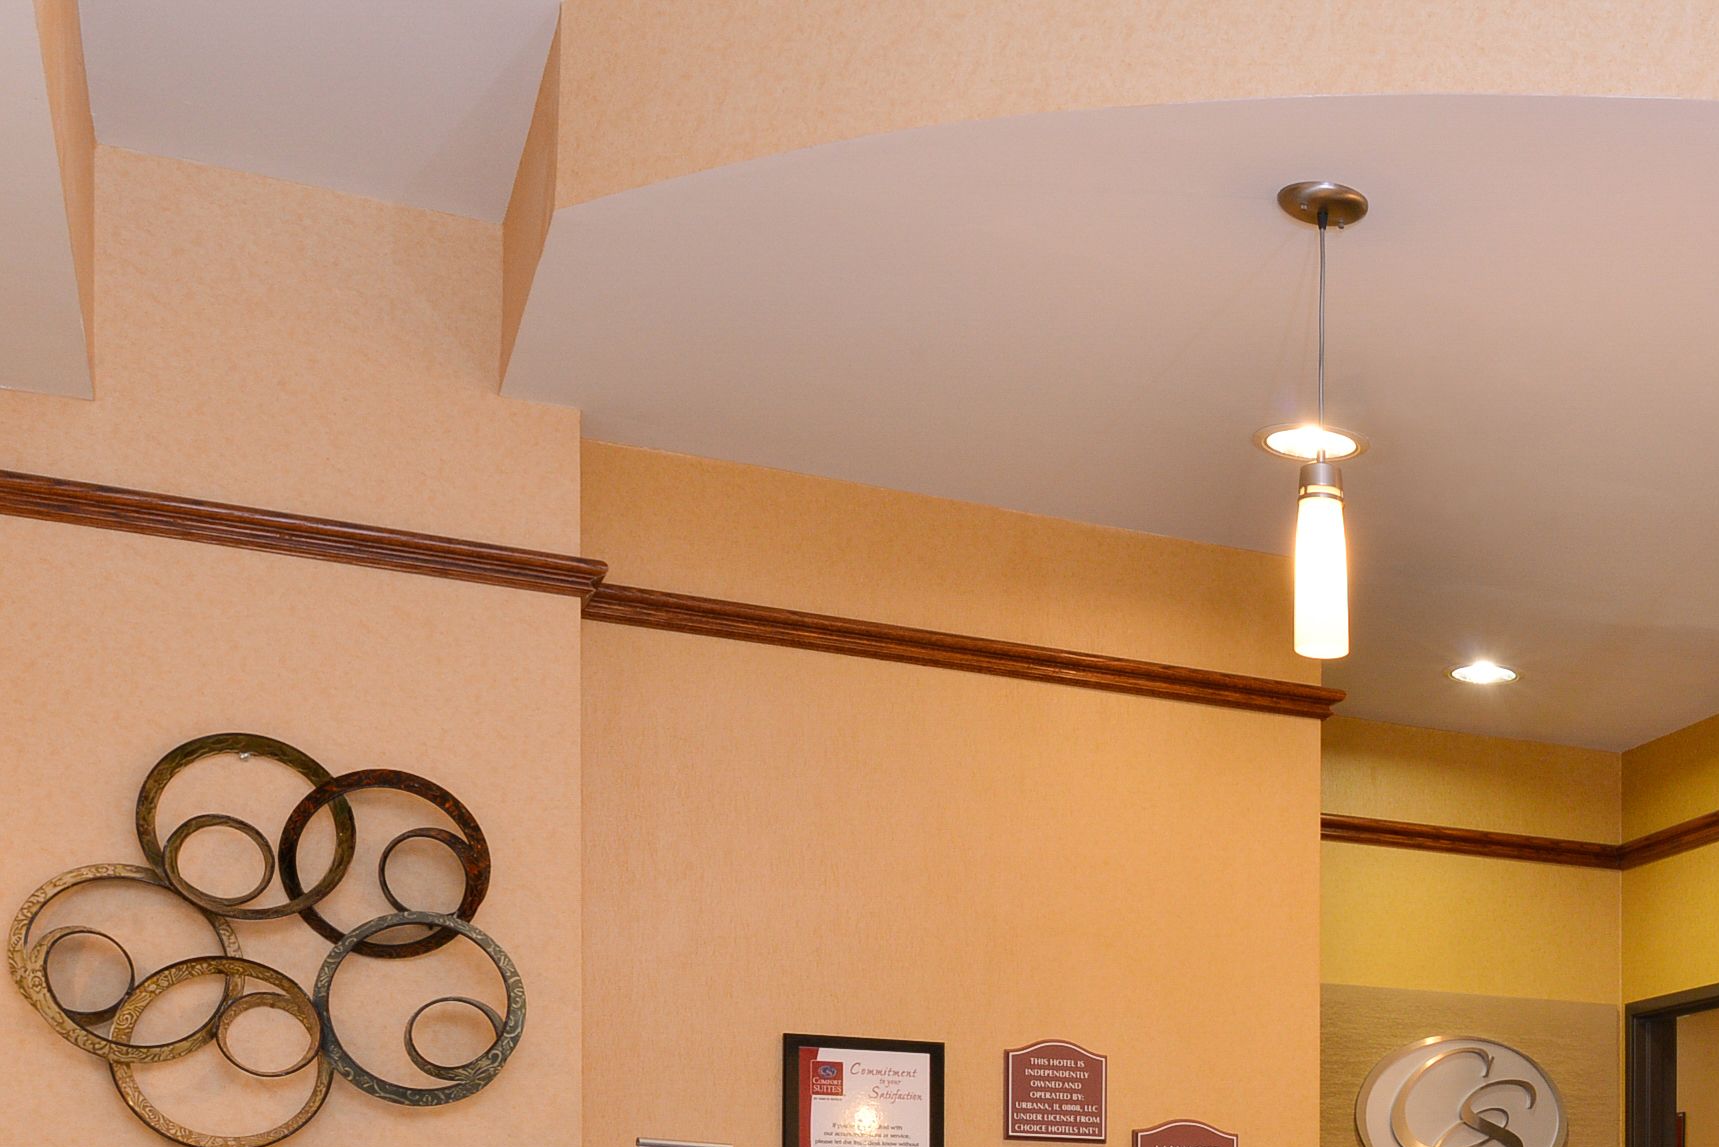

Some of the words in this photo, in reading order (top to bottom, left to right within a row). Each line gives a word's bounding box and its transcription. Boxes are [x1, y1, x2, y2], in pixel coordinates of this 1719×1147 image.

[1031, 1058, 1048, 1066] THIS
[1050, 1058, 1075, 1067] HOTEL
[1077, 1060, 1085, 1068] IS
[850, 1062, 917, 1078] Commitment
[1025, 1068, 1089, 1079] INDEPENDENTLY
[813, 1085, 842, 1093] SUITES
[1030, 1080, 1062, 1089] OWNED
[1063, 1081, 1082, 1090] AND
[868, 1086, 922, 1104] Satisfaction
[1030, 1091, 1071, 1100] OPERATED
[1072, 1093, 1085, 1101] BY:
[1015, 1101, 1052, 1111] URBANA,
[1053, 1103, 1060, 1111] IL
[1084, 1104, 1099, 1113] LLC
[1013, 1112, 1042, 1121] UNDER
[1044, 1113, 1075, 1122] LICENSE
[1076, 1115, 1100, 1124] FROM
[1015, 1123, 1047, 1132] CHOICE
[1048, 1125, 1078, 1134] HOTELS
